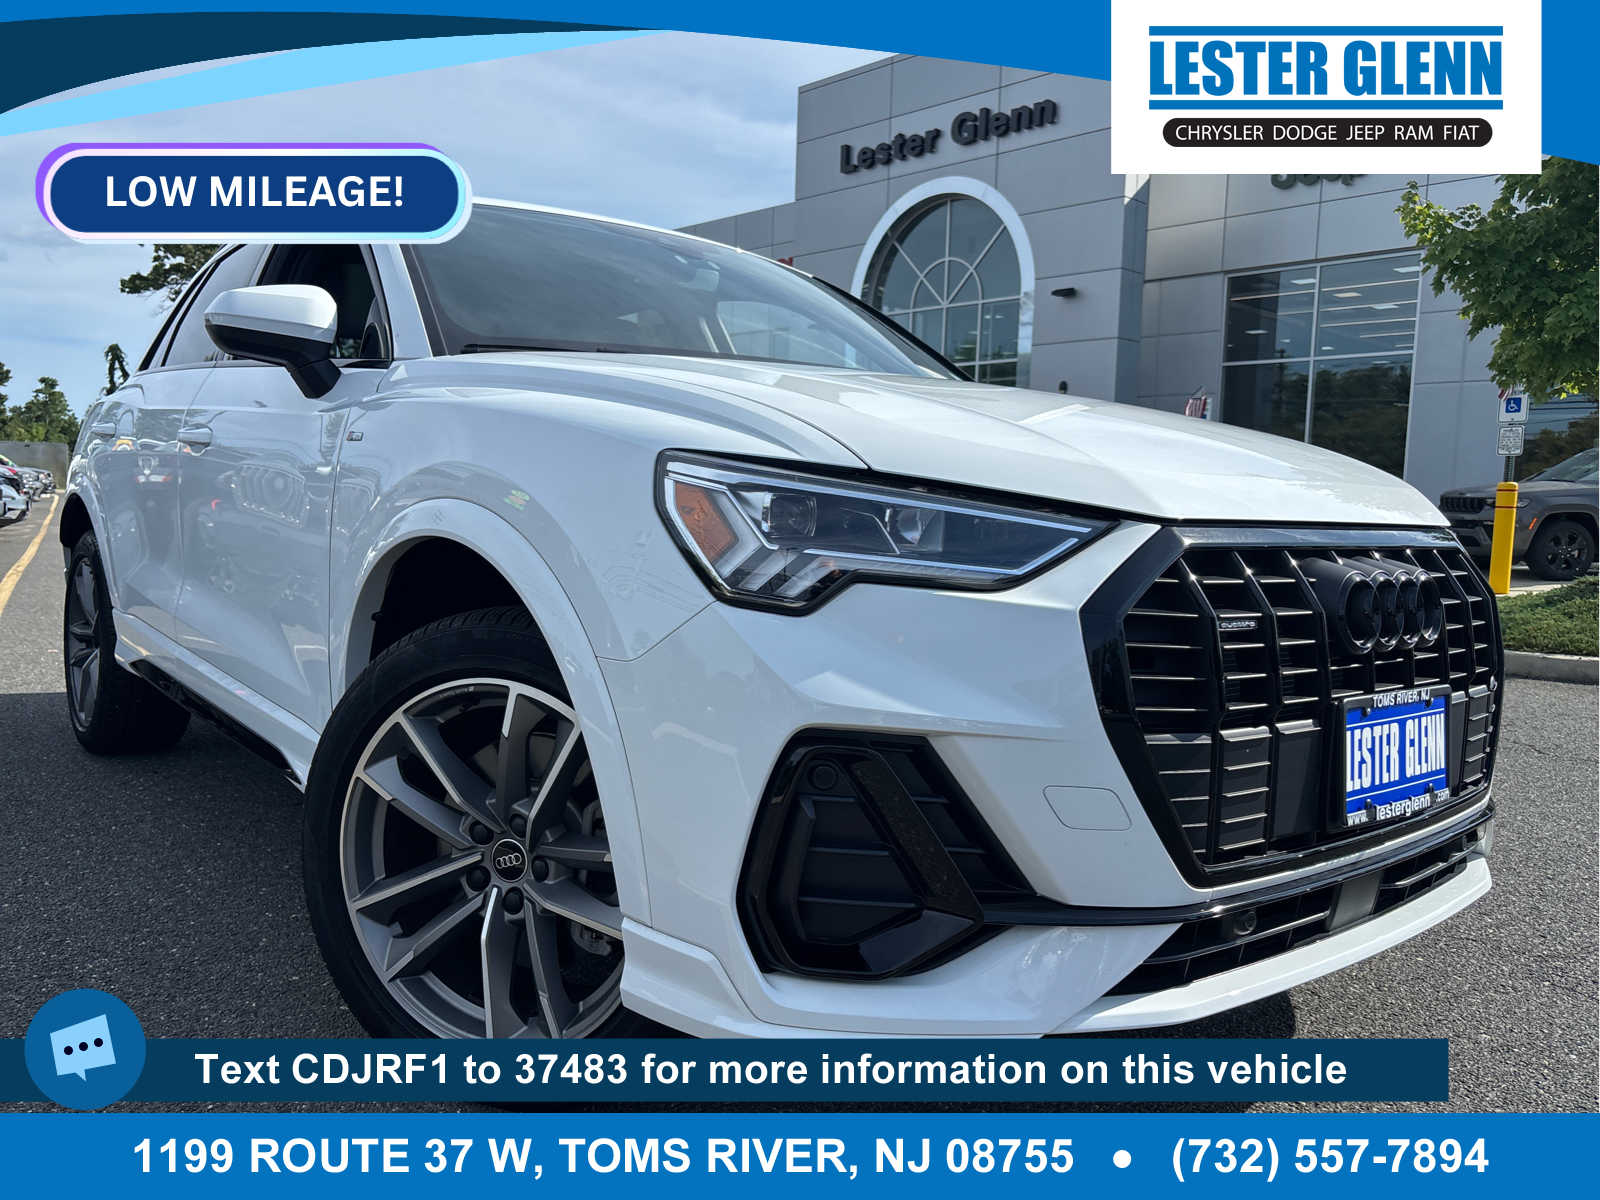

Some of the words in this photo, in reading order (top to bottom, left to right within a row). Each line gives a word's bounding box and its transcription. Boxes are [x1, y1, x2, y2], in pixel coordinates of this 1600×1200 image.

[840, 127, 942, 175] Lester
[950, 99, 1059, 146] Glenn
[1373, 692, 1396, 708] TOMS
[1420, 687, 1430, 701] NJ
[1346, 722, 1400, 792] LESTER
[1405, 713, 1445, 778] GLENN
